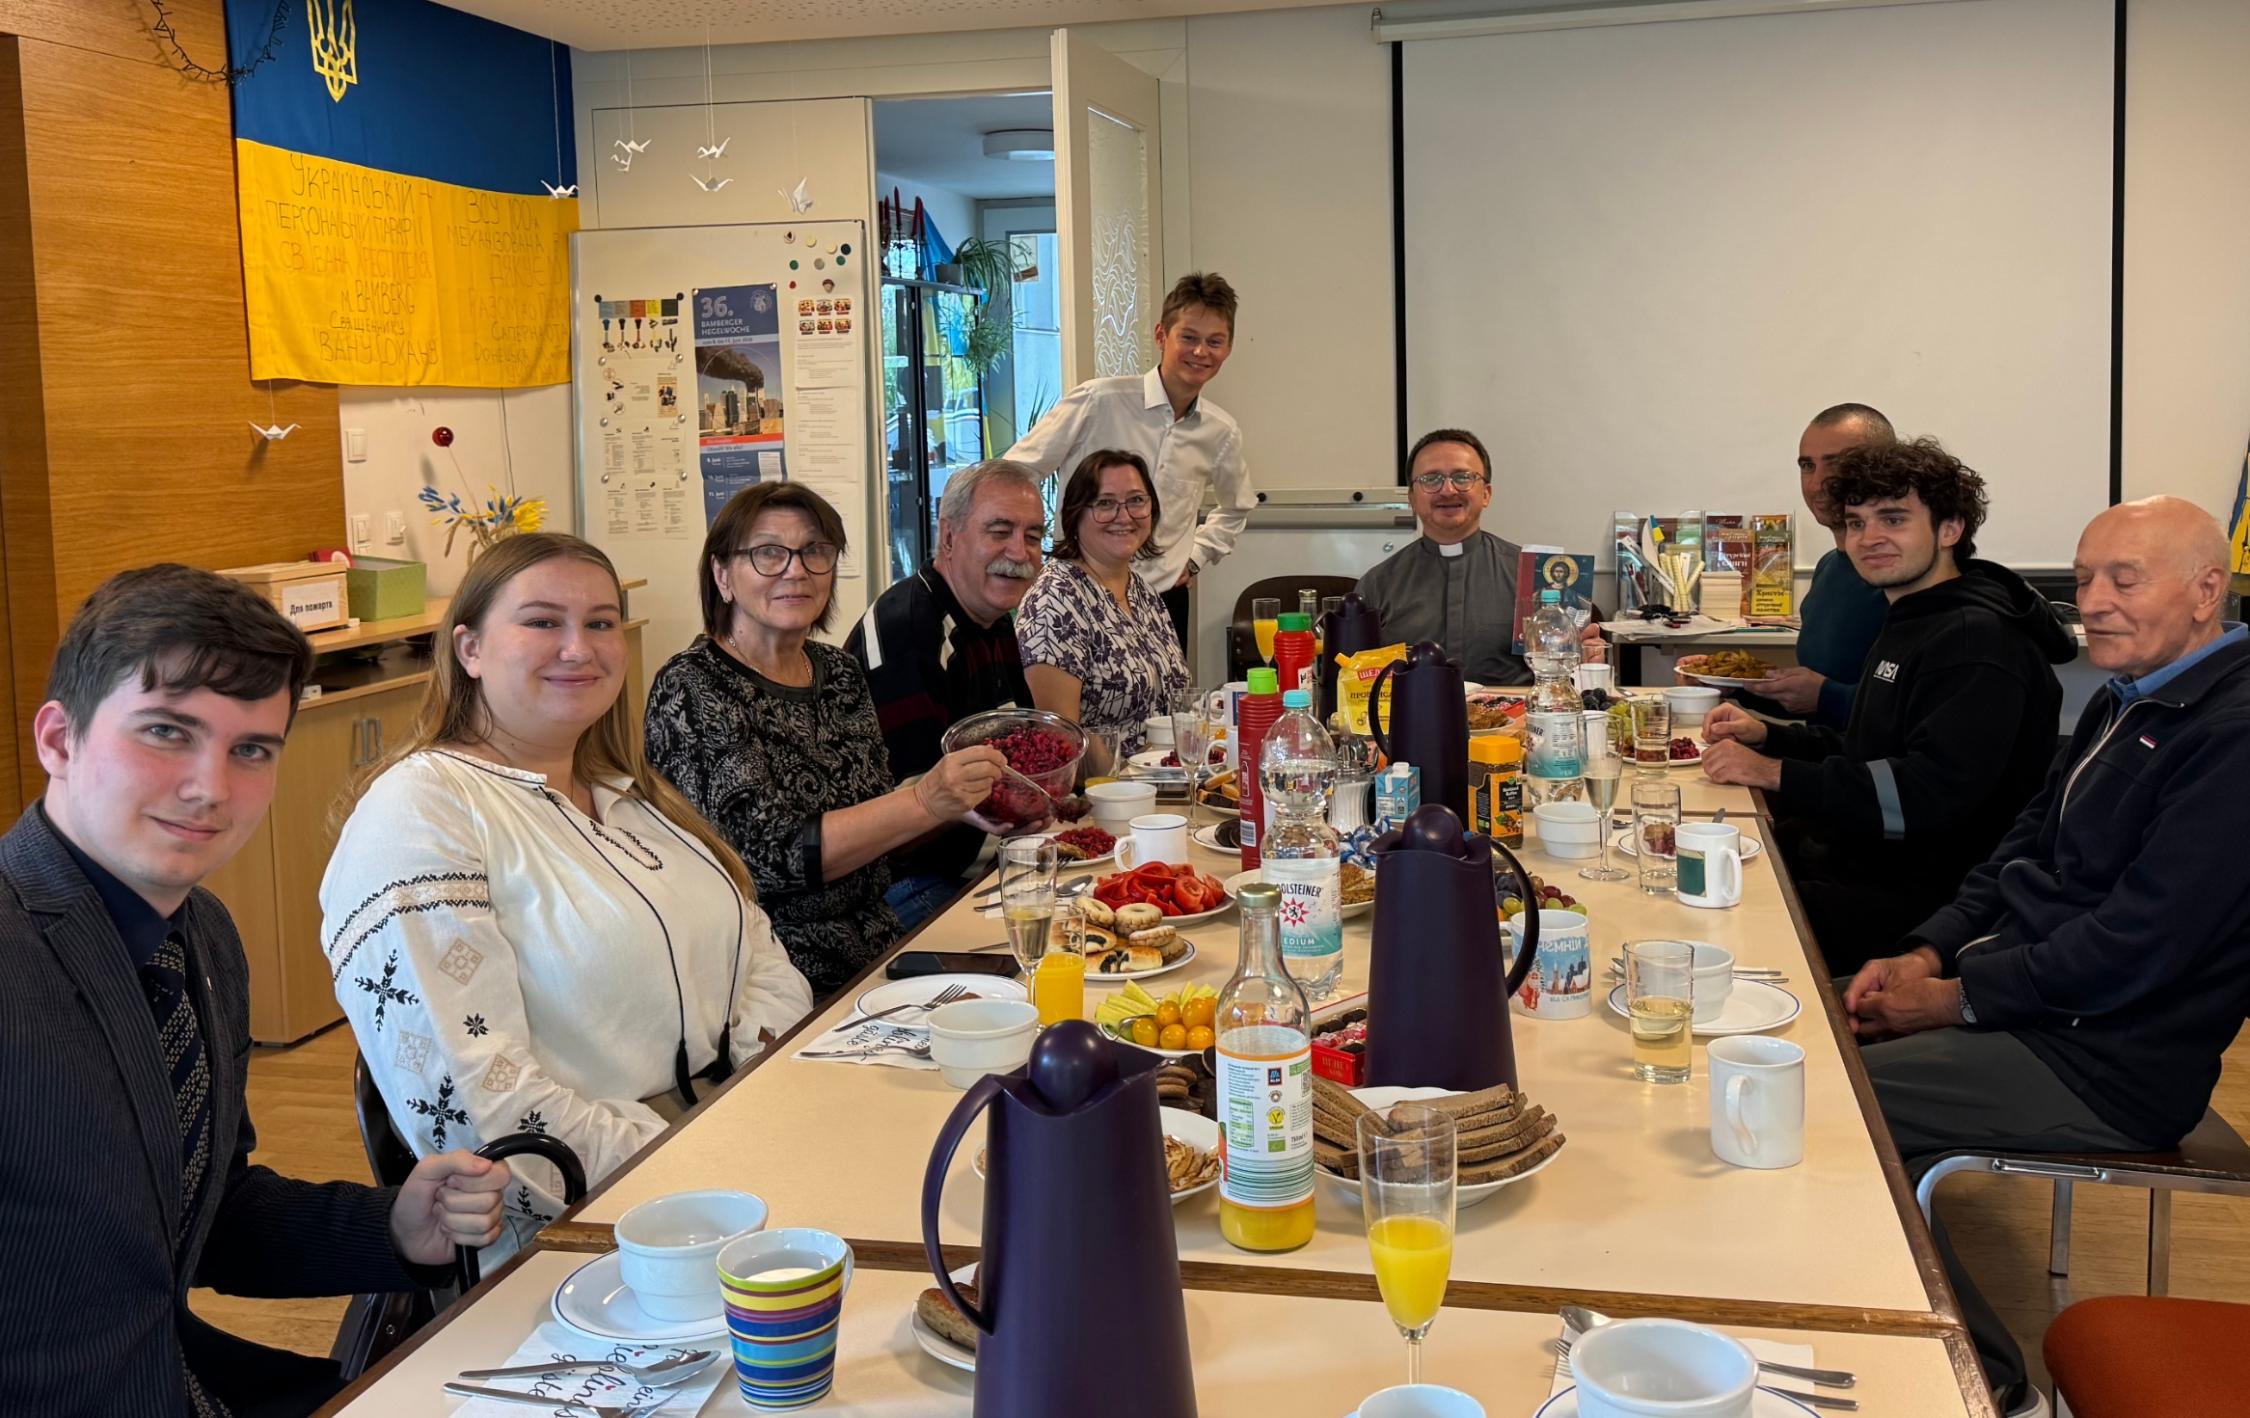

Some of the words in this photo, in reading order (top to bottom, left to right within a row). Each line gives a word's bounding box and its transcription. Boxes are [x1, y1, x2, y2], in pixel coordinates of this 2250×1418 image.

[701, 295, 734, 319] 36.
[701, 318, 744, 328] BAMBERGER
[701, 326, 751, 336] HEGELWOCHE
[1277, 882, 1321, 898] OLSTEINER
[1283, 936, 1315, 946] EDIUM
